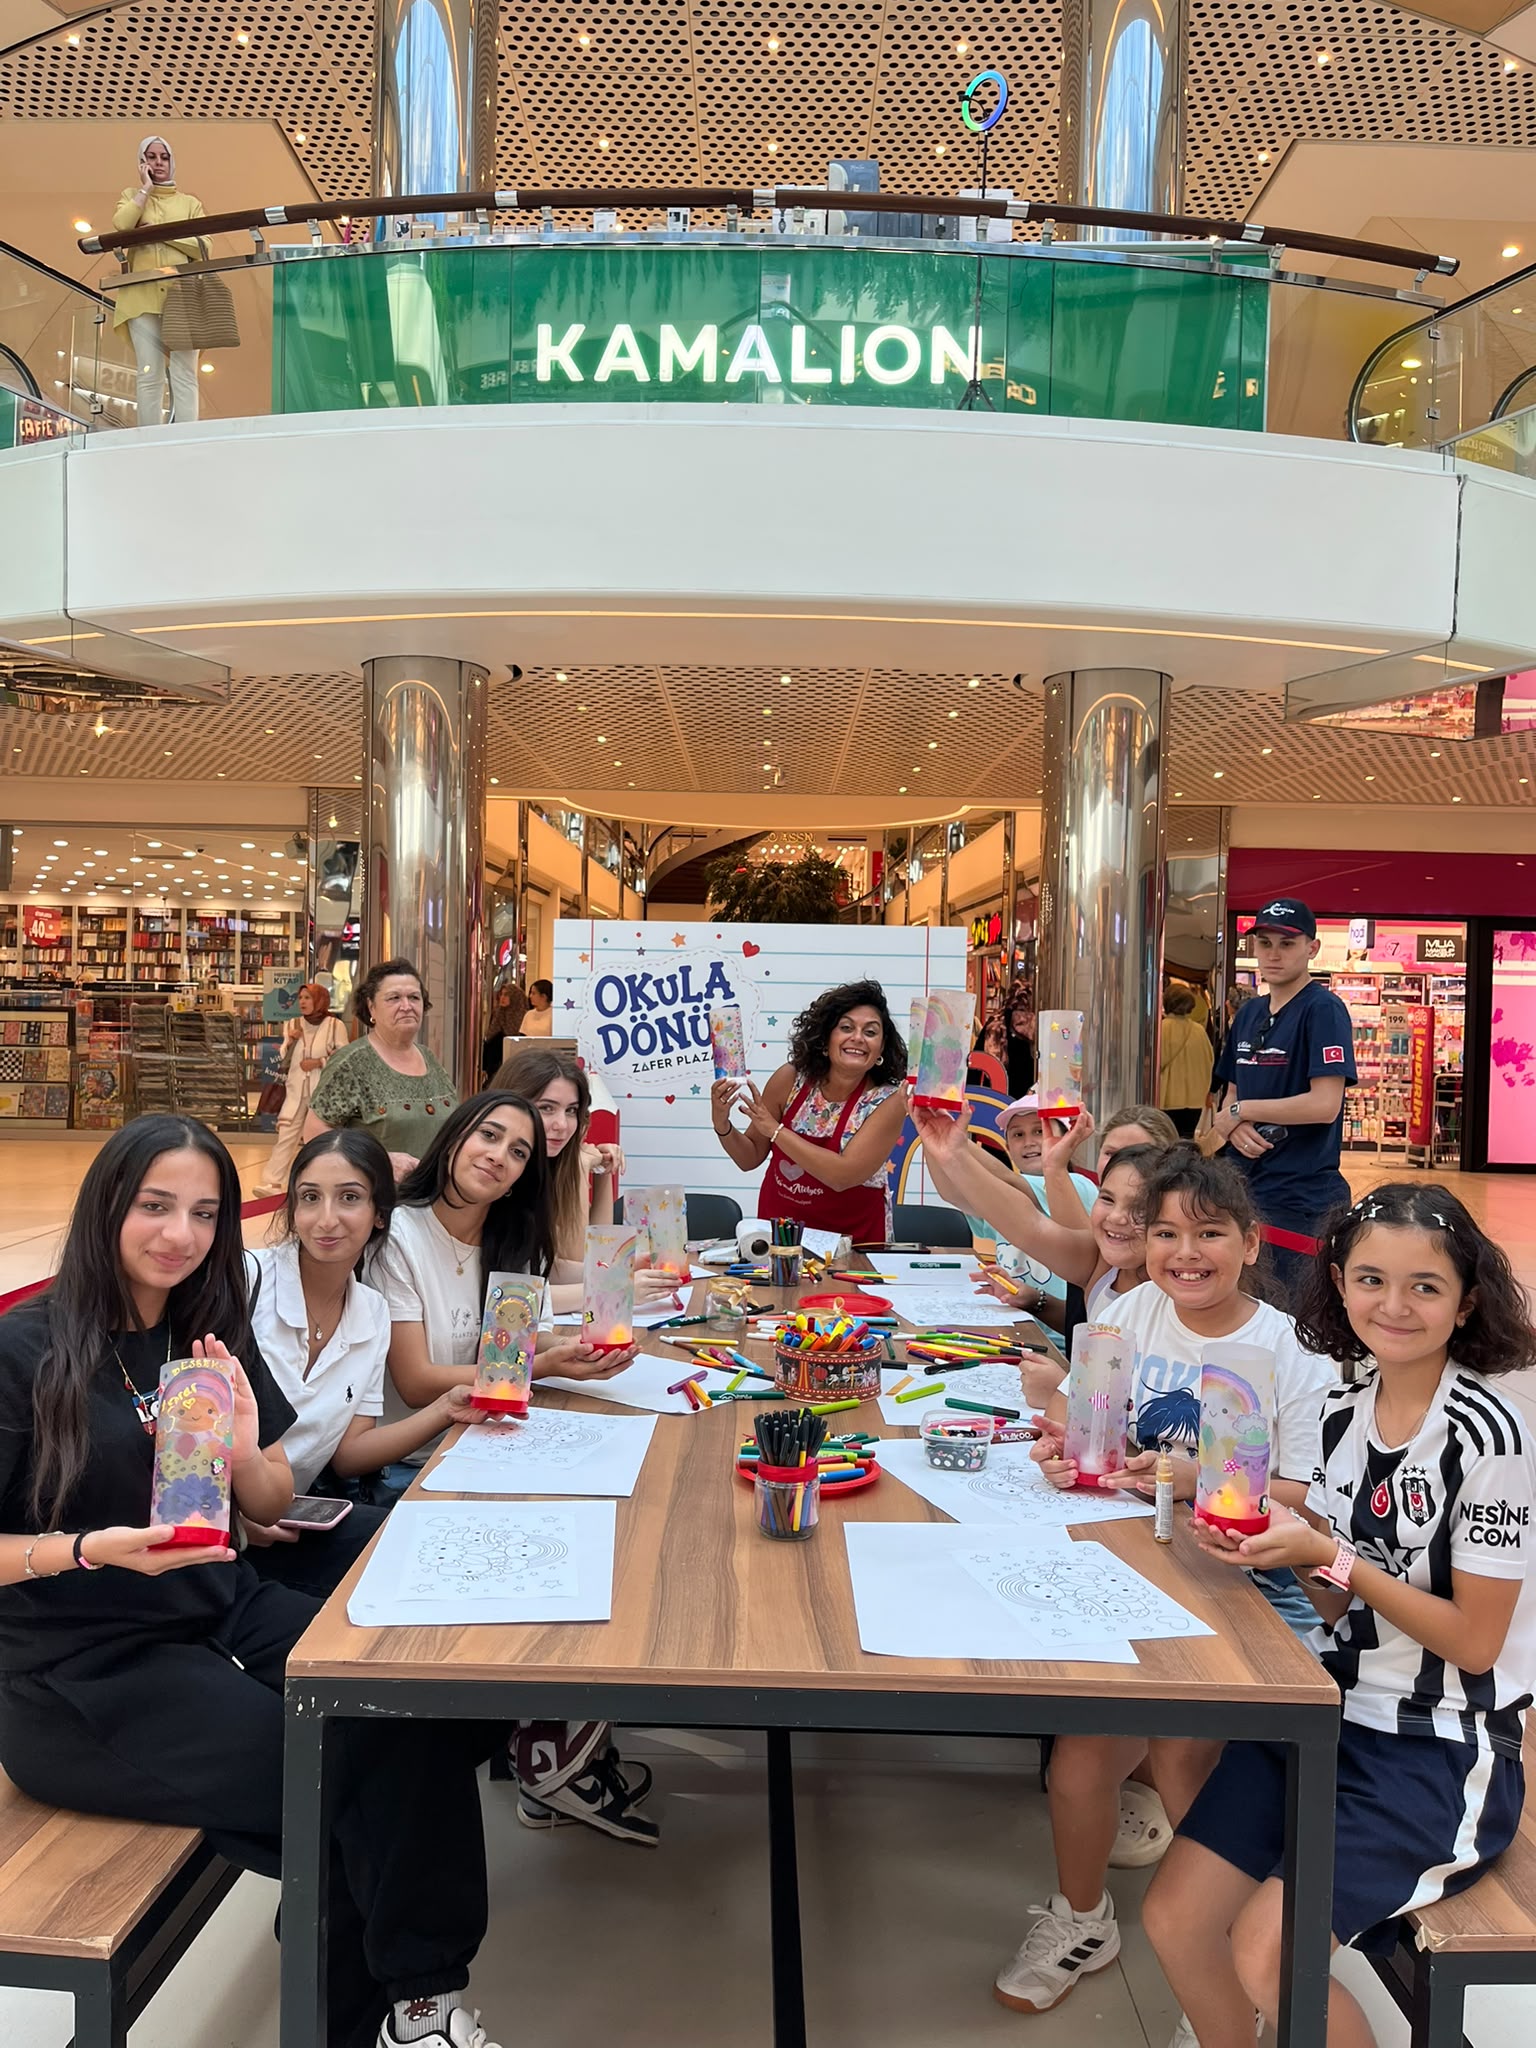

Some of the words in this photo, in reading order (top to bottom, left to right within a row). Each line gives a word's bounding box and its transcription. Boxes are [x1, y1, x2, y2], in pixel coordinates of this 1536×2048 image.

[536, 323, 983, 385] KAMALION
[594, 961, 736, 1018] OKULA
[597, 1003, 740, 1065] DÖNÜ
